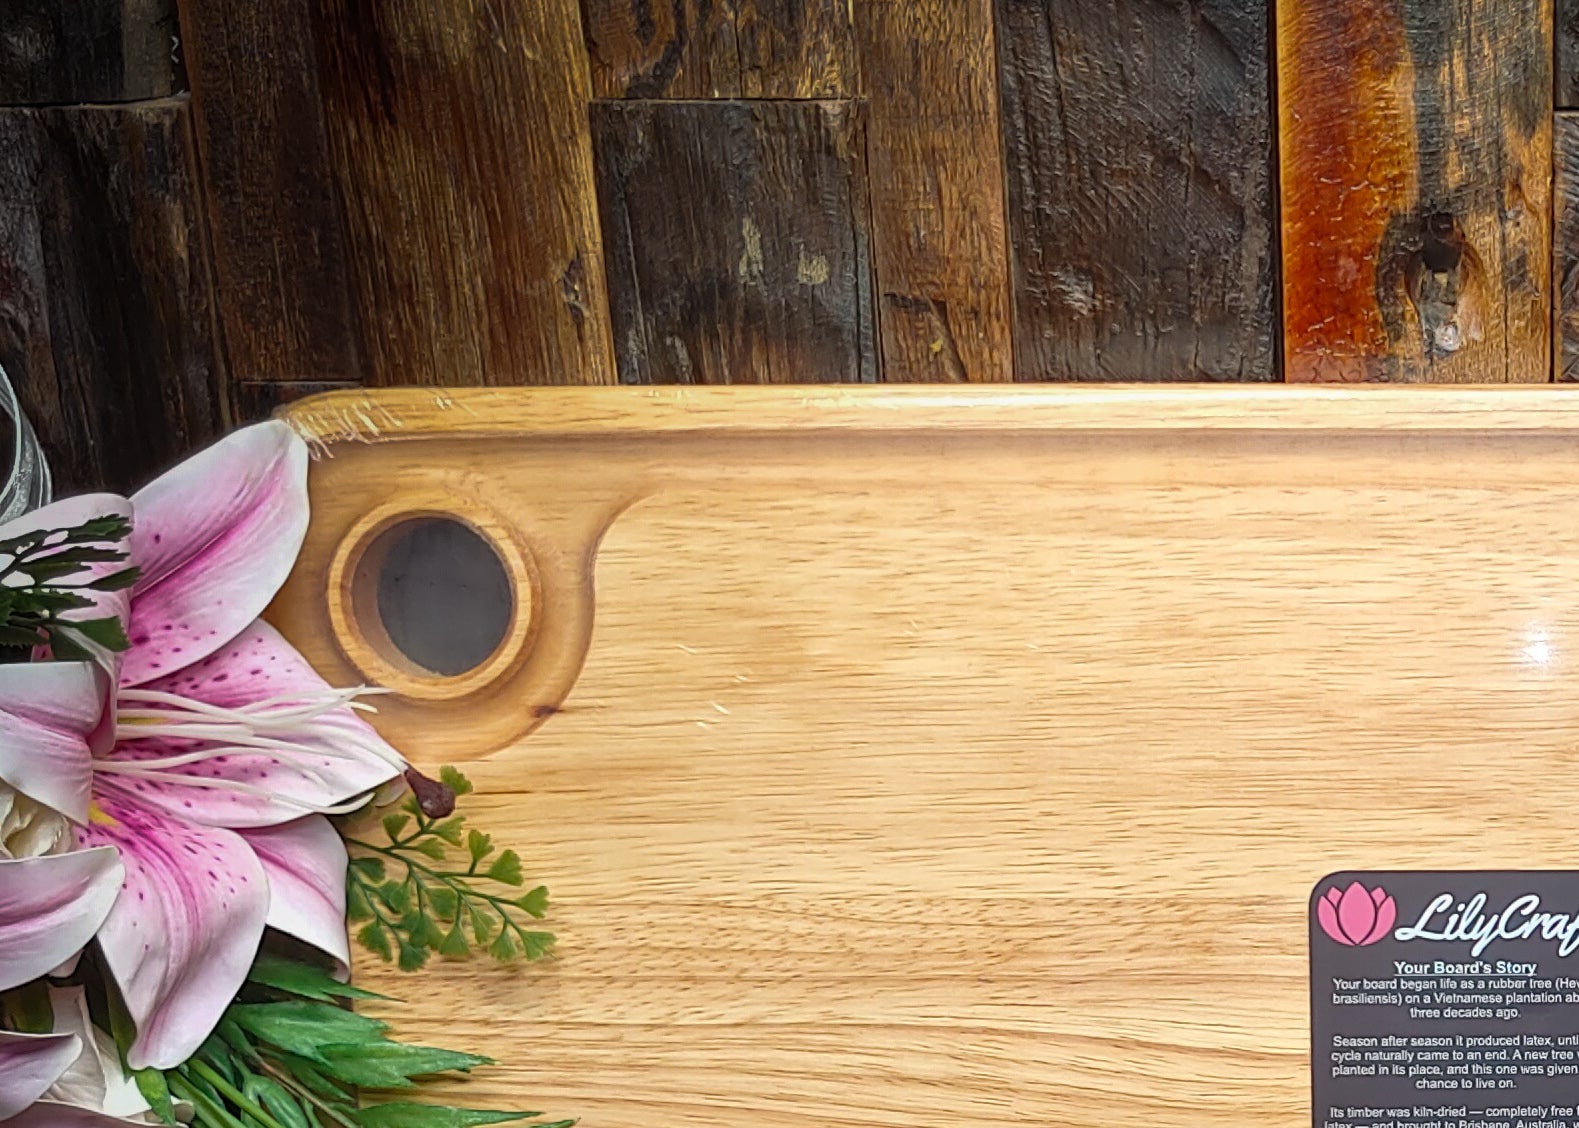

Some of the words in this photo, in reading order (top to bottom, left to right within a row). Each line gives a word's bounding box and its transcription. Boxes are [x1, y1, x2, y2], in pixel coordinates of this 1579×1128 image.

[1394, 961, 1430, 976] Your
[1434, 960, 1491, 976] Board's
[1496, 960, 1536, 976] Story
[1332, 978, 1361, 990] Your
[1362, 978, 1397, 990] board
[1400, 978, 1437, 992] began
[1439, 977, 1457, 990] life
[1460, 979, 1474, 990] as
[1477, 979, 1485, 990] a
[1488, 977, 1526, 990] rubber
[1529, 978, 1552, 990] tree
[1332, 992, 1402, 1006] brasiliensis)
[1404, 994, 1420, 1004] on
[1422, 994, 1431, 1004] a
[1433, 992, 1503, 1004] Vietnamese
[1505, 991, 1562, 1006] plantation
[1410, 1007, 1440, 1019] three
[1442, 1006, 1493, 1019] decades
[1495, 1008, 1521, 1021] ago.
[1332, 1035, 1378, 1047] Season
[1381, 1035, 1408, 1047] after
[1410, 1037, 1453, 1046] season
[1455, 1034, 1463, 1046] it
[1466, 1035, 1520, 1048] produced
[1330, 1049, 1361, 1063] cycle
[1364, 1049, 1414, 1063] naturally
[1416, 1051, 1449, 1061] came
[1452, 1049, 1464, 1061] to
[1466, 1051, 1481, 1061] an
[1484, 1048, 1510, 1061] end.
[1512, 1048, 1522, 1061] A
[1524, 1051, 1548, 1061] new
[1551, 1049, 1573, 1060] tree
[1332, 1064, 1375, 1078] planted
[1378, 1063, 1389, 1076] in
[1392, 1063, 1405, 1076] its
[1446, 1063, 1468, 1075] and
[1471, 1063, 1492, 1075] this
[1495, 1065, 1517, 1075] one
[1520, 1065, 1544, 1075] was
[1546, 1064, 1578, 1077] given
[1415, 1079, 1458, 1090] chance
[1460, 1078, 1472, 1090] to
[1475, 1077, 1495, 1089] live
[1498, 1079, 1516, 1089] on.
[1330, 1106, 1344, 1118] Its
[1346, 1106, 1384, 1118] timber
[1386, 1108, 1410, 1118] was
[1412, 1105, 1466, 1118] kiln-dried
[1485, 1105, 1548, 1119] completely
[1550, 1104, 1573, 1117] free
